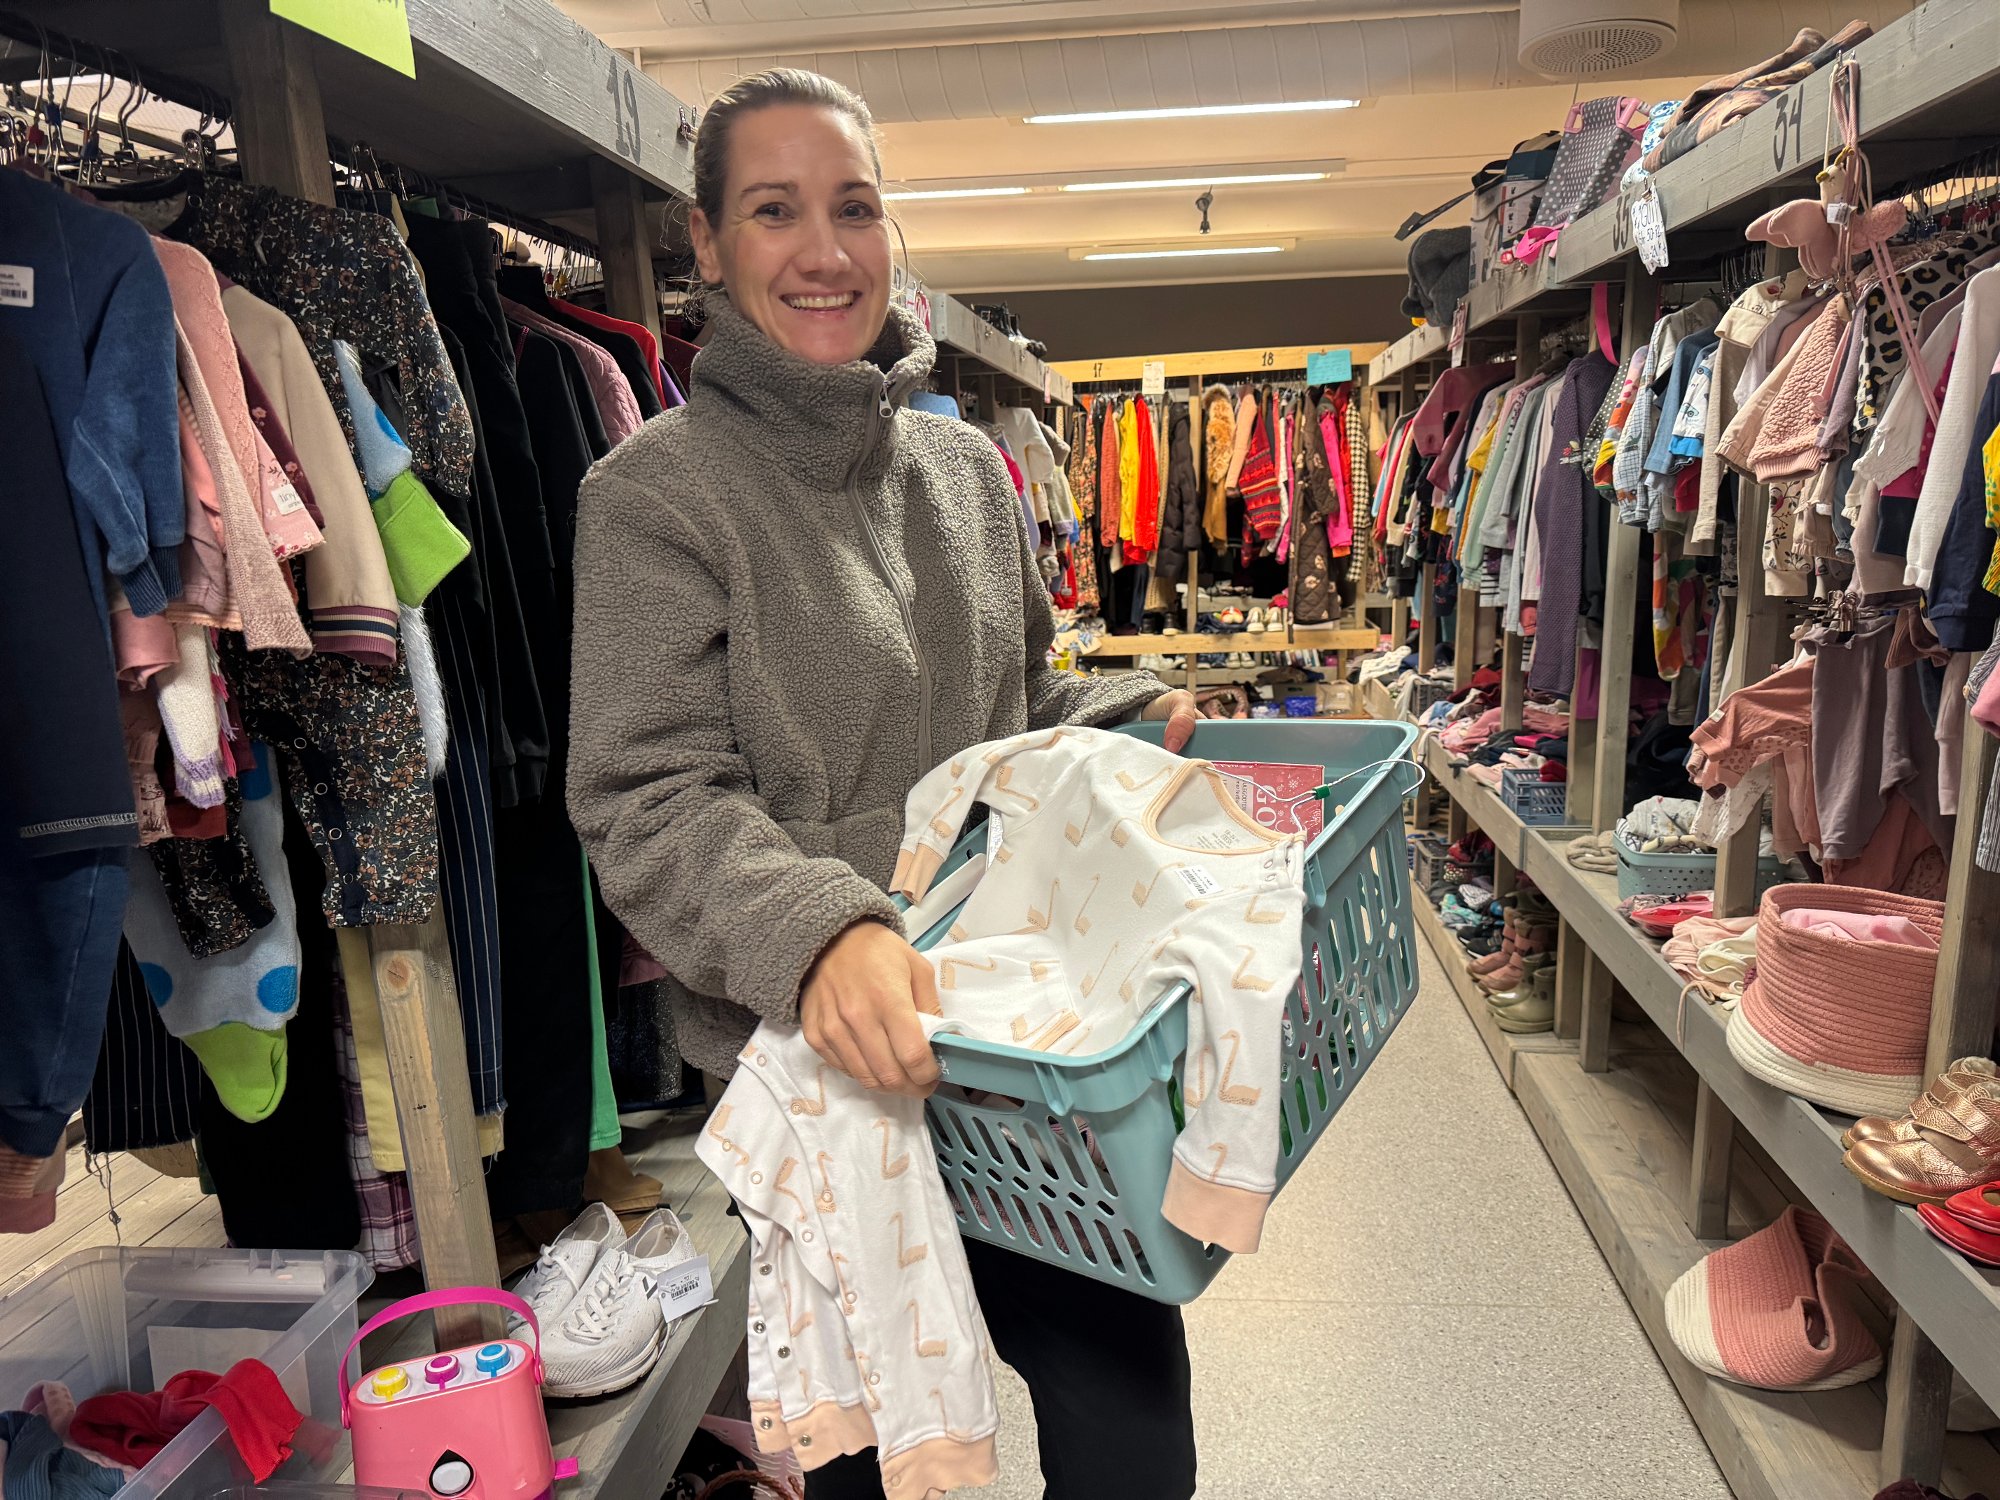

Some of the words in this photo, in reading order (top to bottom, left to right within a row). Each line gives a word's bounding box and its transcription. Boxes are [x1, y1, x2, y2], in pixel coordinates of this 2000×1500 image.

[606, 55, 641, 166] 19
[1773, 83, 1804, 173] 34
[1612, 193, 1631, 252] 35
[1093, 363, 1103, 378] 17
[1262, 352, 1274, 366] 18
